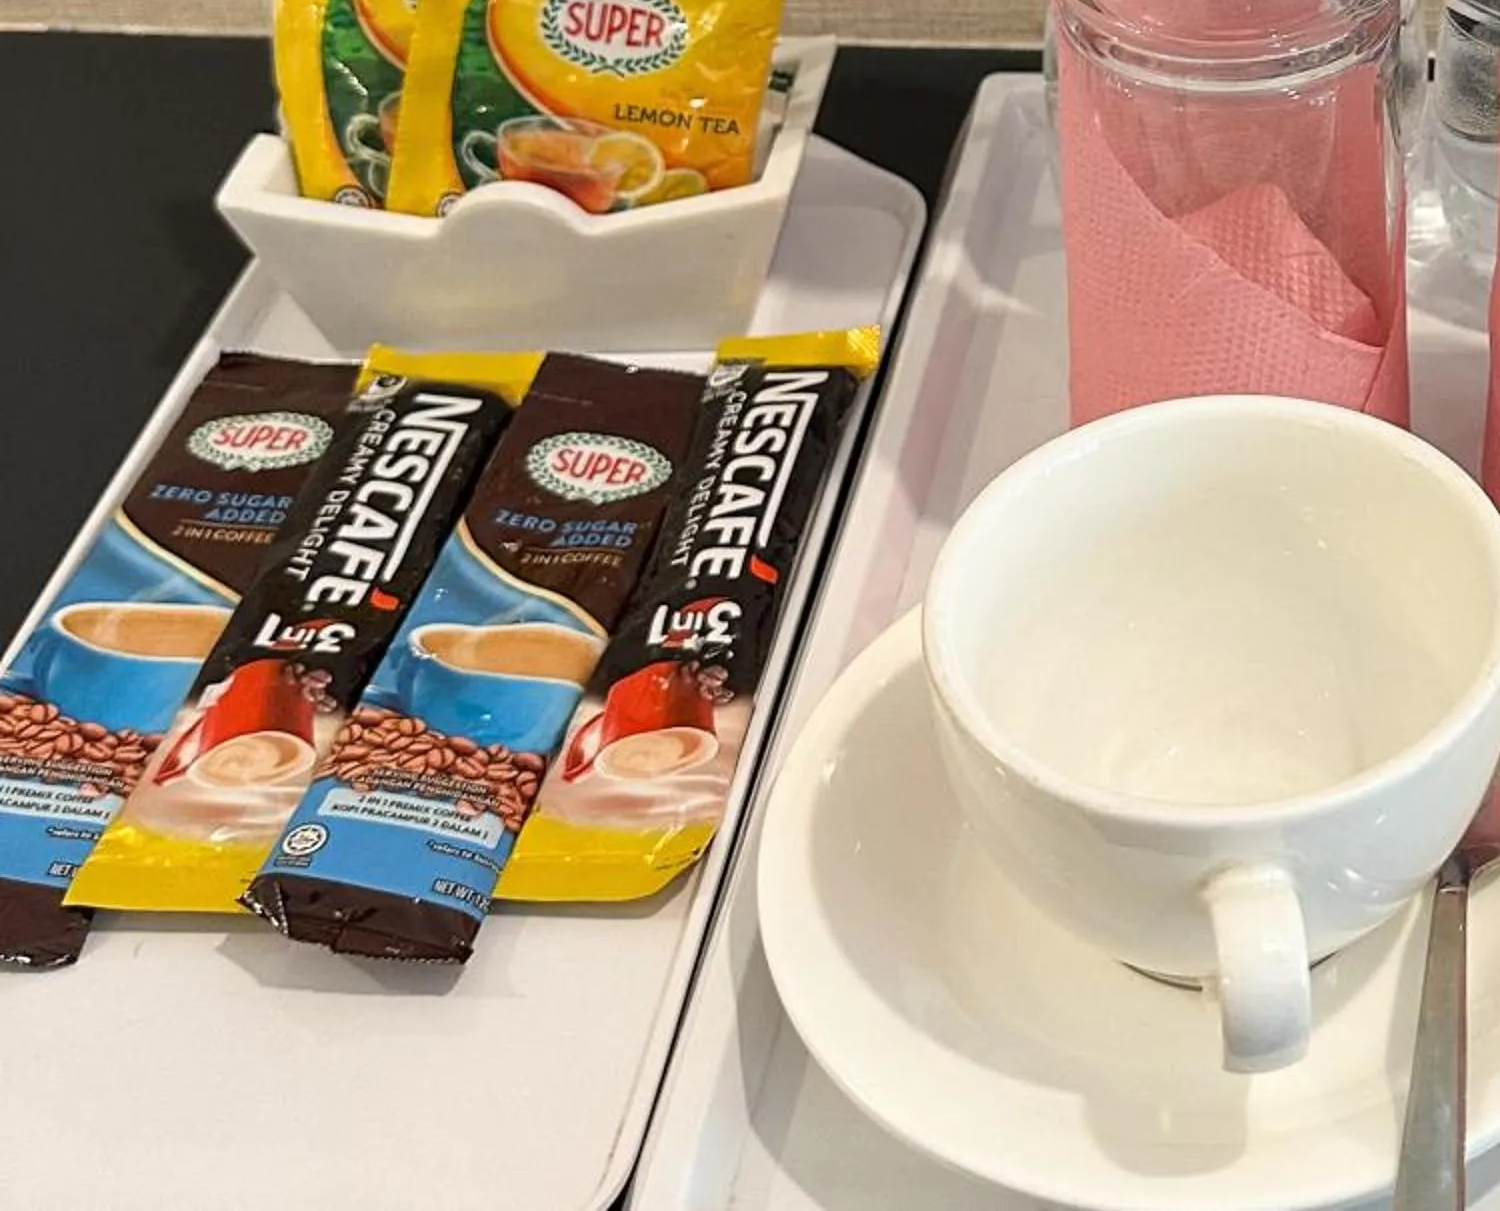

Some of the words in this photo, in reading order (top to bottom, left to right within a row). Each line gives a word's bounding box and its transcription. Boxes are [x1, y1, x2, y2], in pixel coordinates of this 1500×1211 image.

[564, 1, 666, 48] SUPER
[614, 103, 692, 130] LEMON
[698, 116, 741, 135] TEA
[213, 424, 309, 450] SUPER
[340, 409, 397, 484] CREAMY
[705, 391, 748, 472] CREAMY
[552, 448, 647, 485] SUPER
[151, 485, 212, 503] ZERO
[217, 492, 293, 509] SUGAR
[205, 508, 287, 524] ADDED
[496, 510, 556, 532] ZERO
[561, 521, 638, 535] SUGAR
[671, 477, 716, 566] DELIGHT
[285, 490, 350, 581] DELIGHT
[552, 534, 633, 547] ADDED
